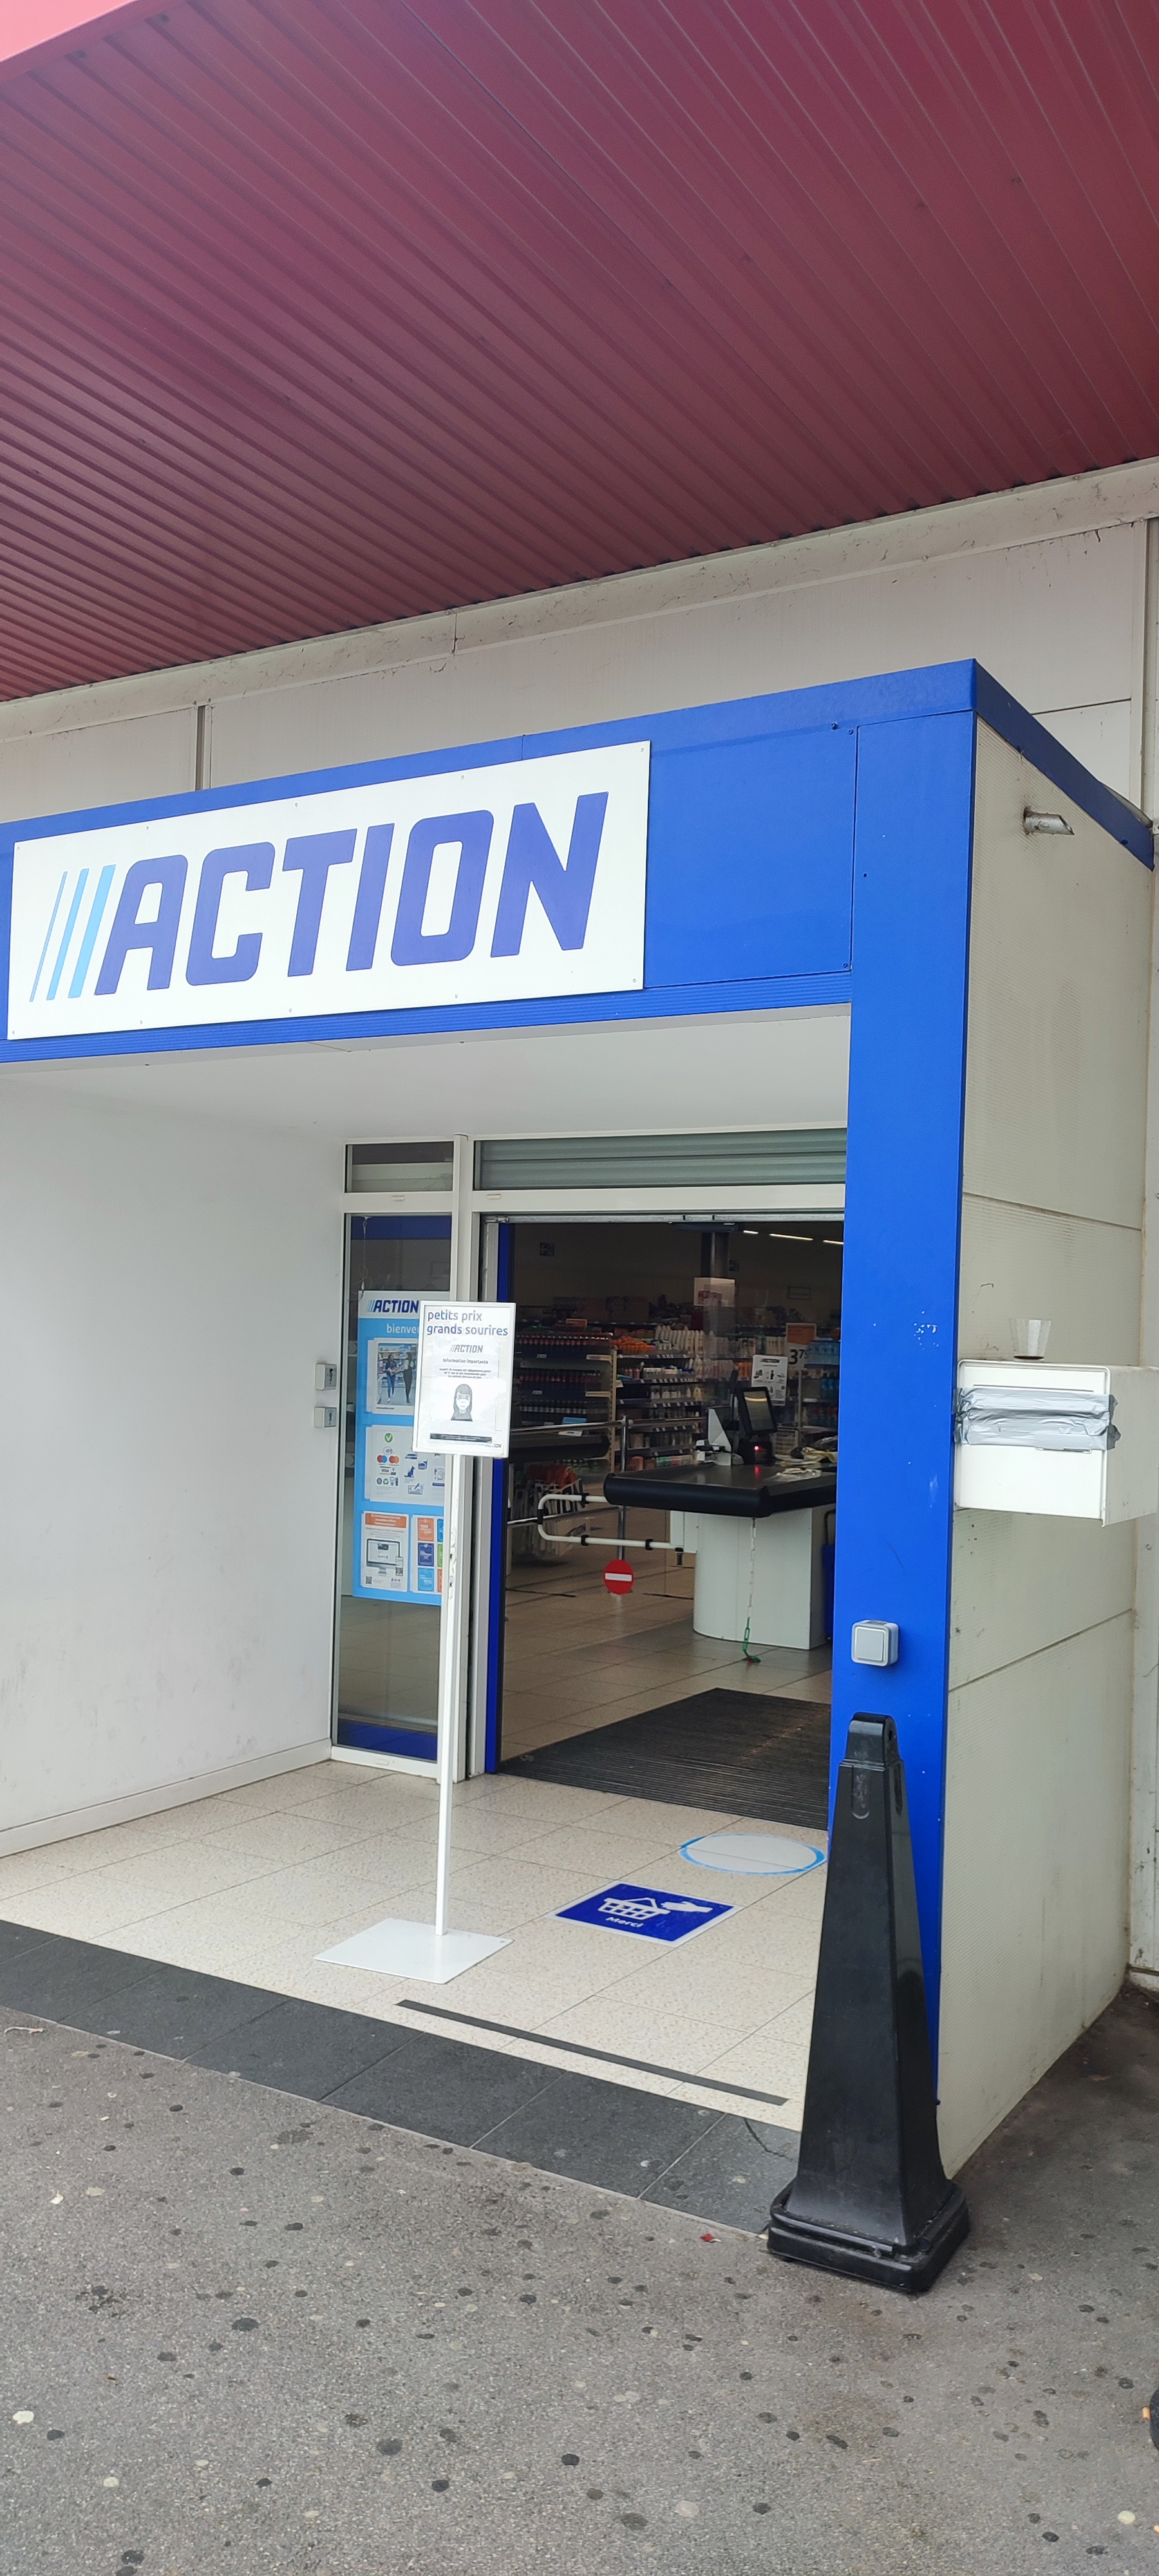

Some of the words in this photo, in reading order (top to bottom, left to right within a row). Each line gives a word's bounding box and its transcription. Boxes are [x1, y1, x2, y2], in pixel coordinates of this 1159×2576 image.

[94, 791, 609, 996] ACTION
[372, 1300, 419, 1313] ACTION
[428, 1309, 458, 1322] petits
[462, 1310, 482, 1323] prix
[386, 1323, 419, 1334] bienve
[427, 1323, 462, 1336] grands
[465, 1325, 508, 1336] sourires
[454, 1345, 483, 1353] ACTION
[605, 1917, 644, 1927] Merci
